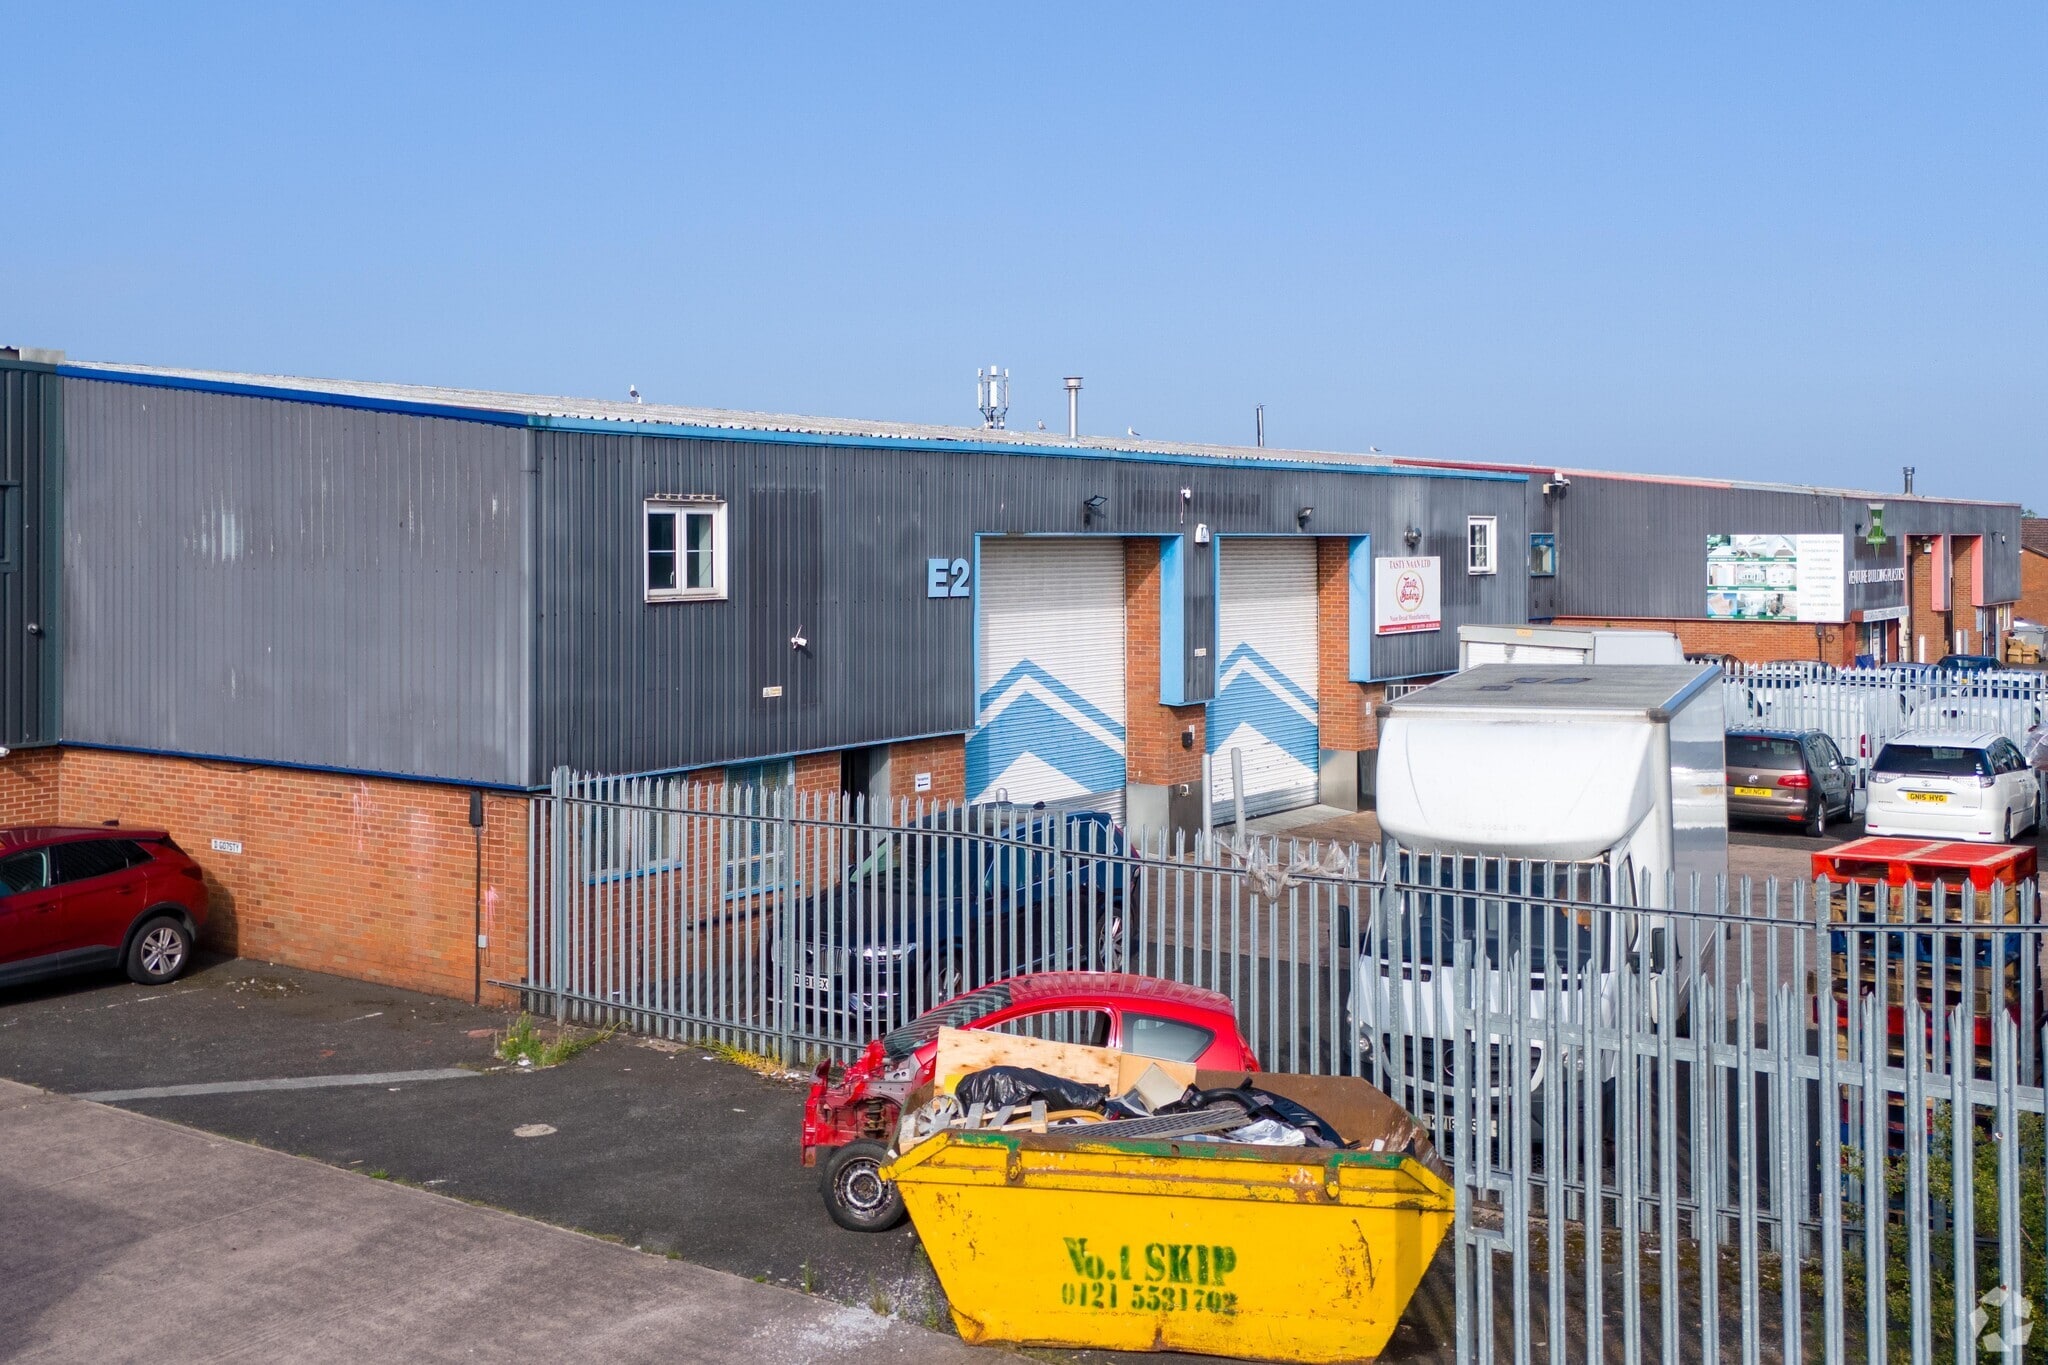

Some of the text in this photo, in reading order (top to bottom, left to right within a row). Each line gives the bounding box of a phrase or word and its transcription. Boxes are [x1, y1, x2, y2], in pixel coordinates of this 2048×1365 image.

[1389, 559, 1431, 569] TASTY NAAN LTD
[928, 558, 970, 597] E2
[1848, 567, 1904, 584] VENTURE BUILDING PLASTICS
[1910, 793, 1944, 802] GN15 HYG
[1145, 1243, 1237, 1286] SKIP
[1062, 1282, 1118, 1309] 0121
